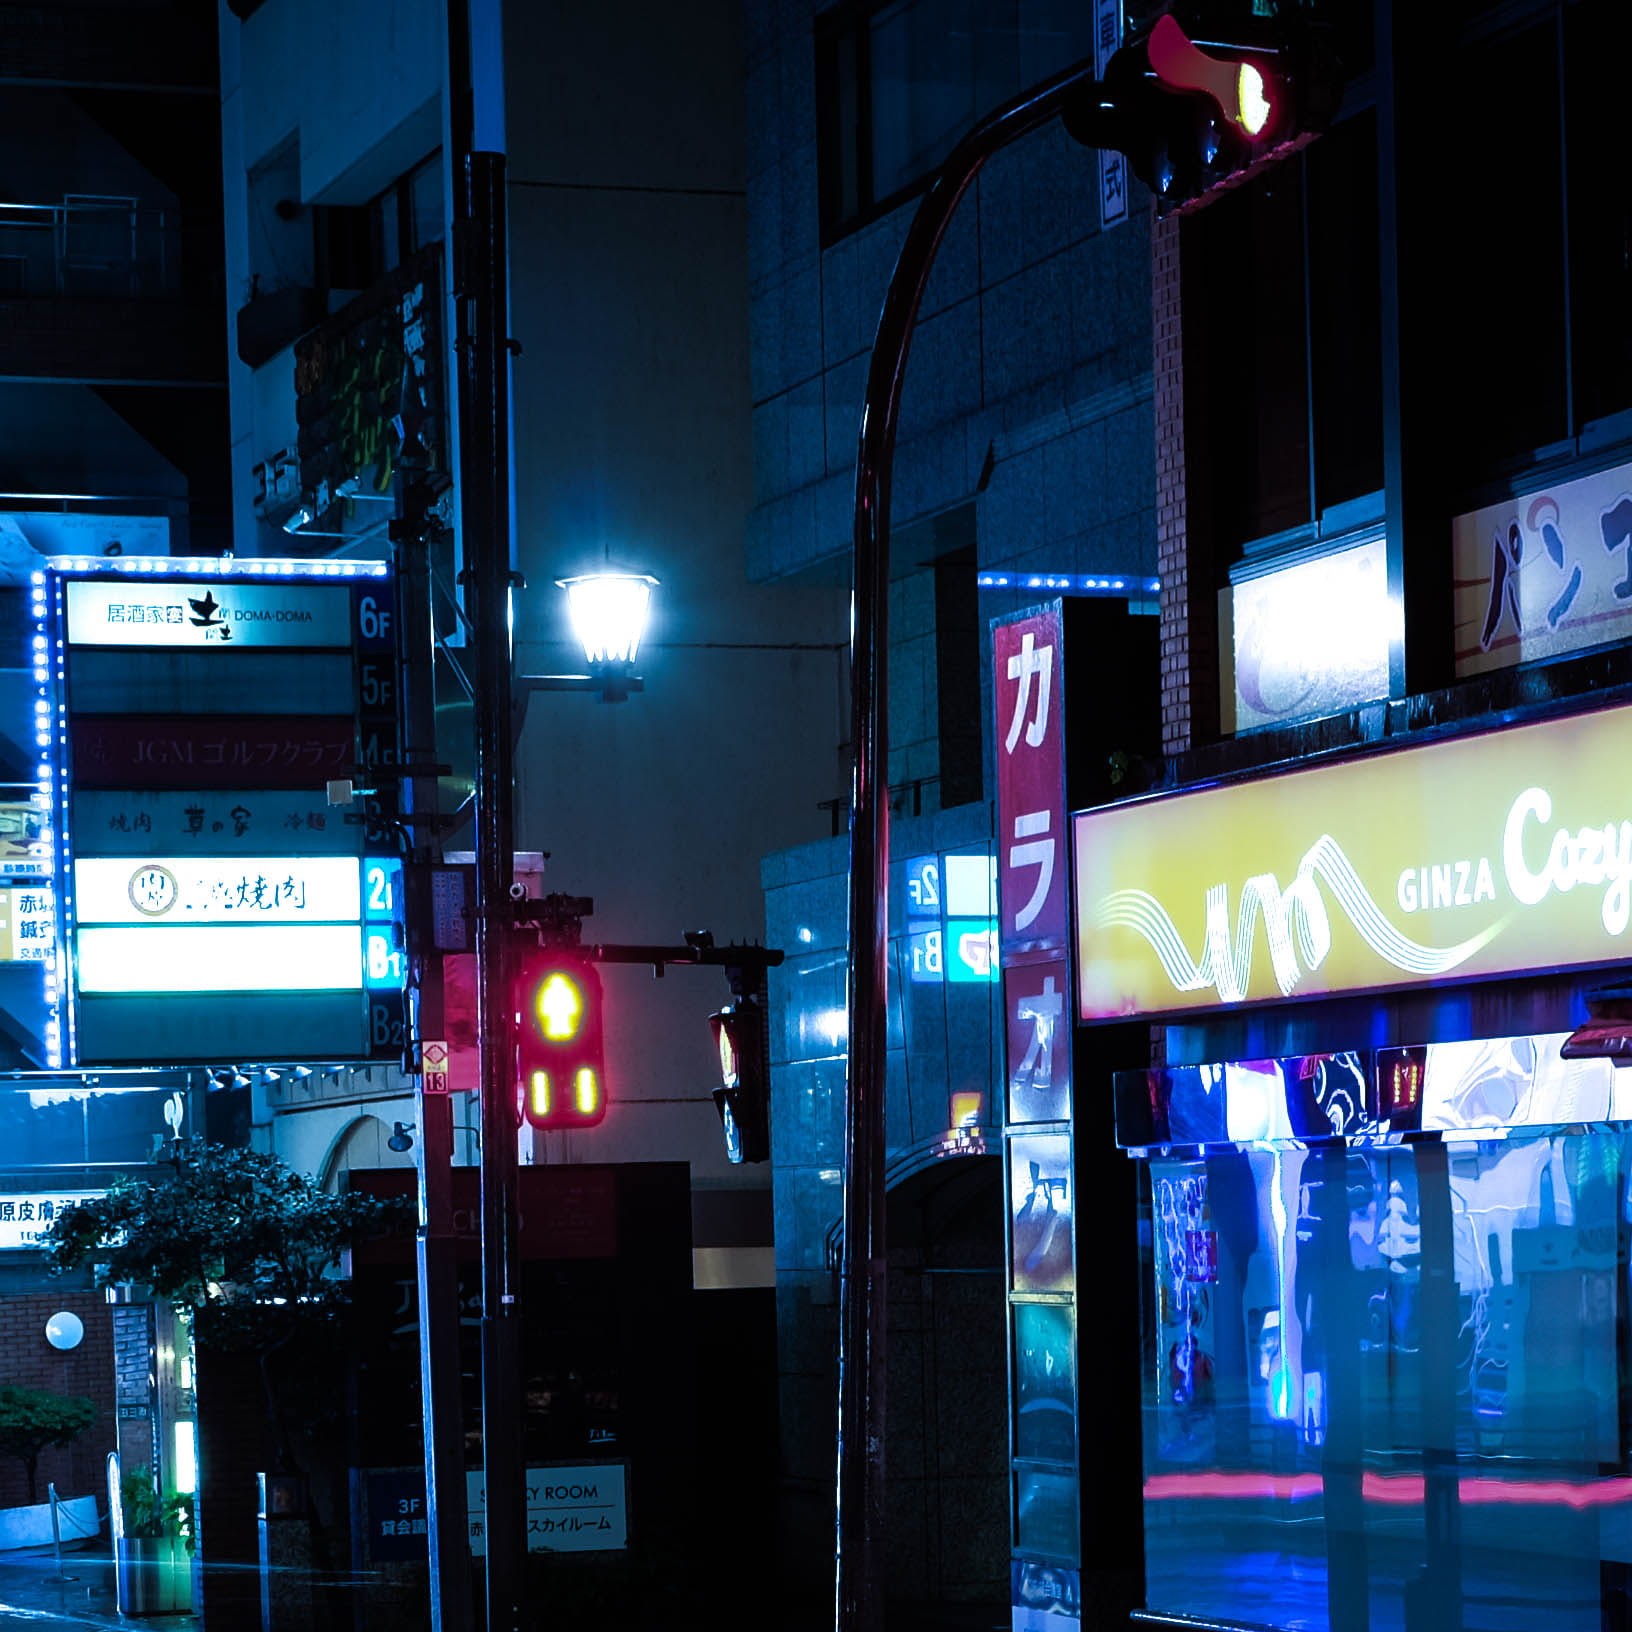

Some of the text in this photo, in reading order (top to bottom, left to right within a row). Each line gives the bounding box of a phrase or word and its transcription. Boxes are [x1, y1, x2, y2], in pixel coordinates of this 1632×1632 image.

[360, 596, 391, 638] 6F
[362, 665, 392, 704] 5F
[1397, 858, 1496, 913] GINZA
[369, 936, 401, 979] B1
[1005, 632, 1067, 1270] カラオケ
[371, 1004, 402, 1046] B2
[428, 1073, 445, 1091] 13
[397, 1498, 422, 1515] 3F
[545, 1485, 598, 1501] ROOM
